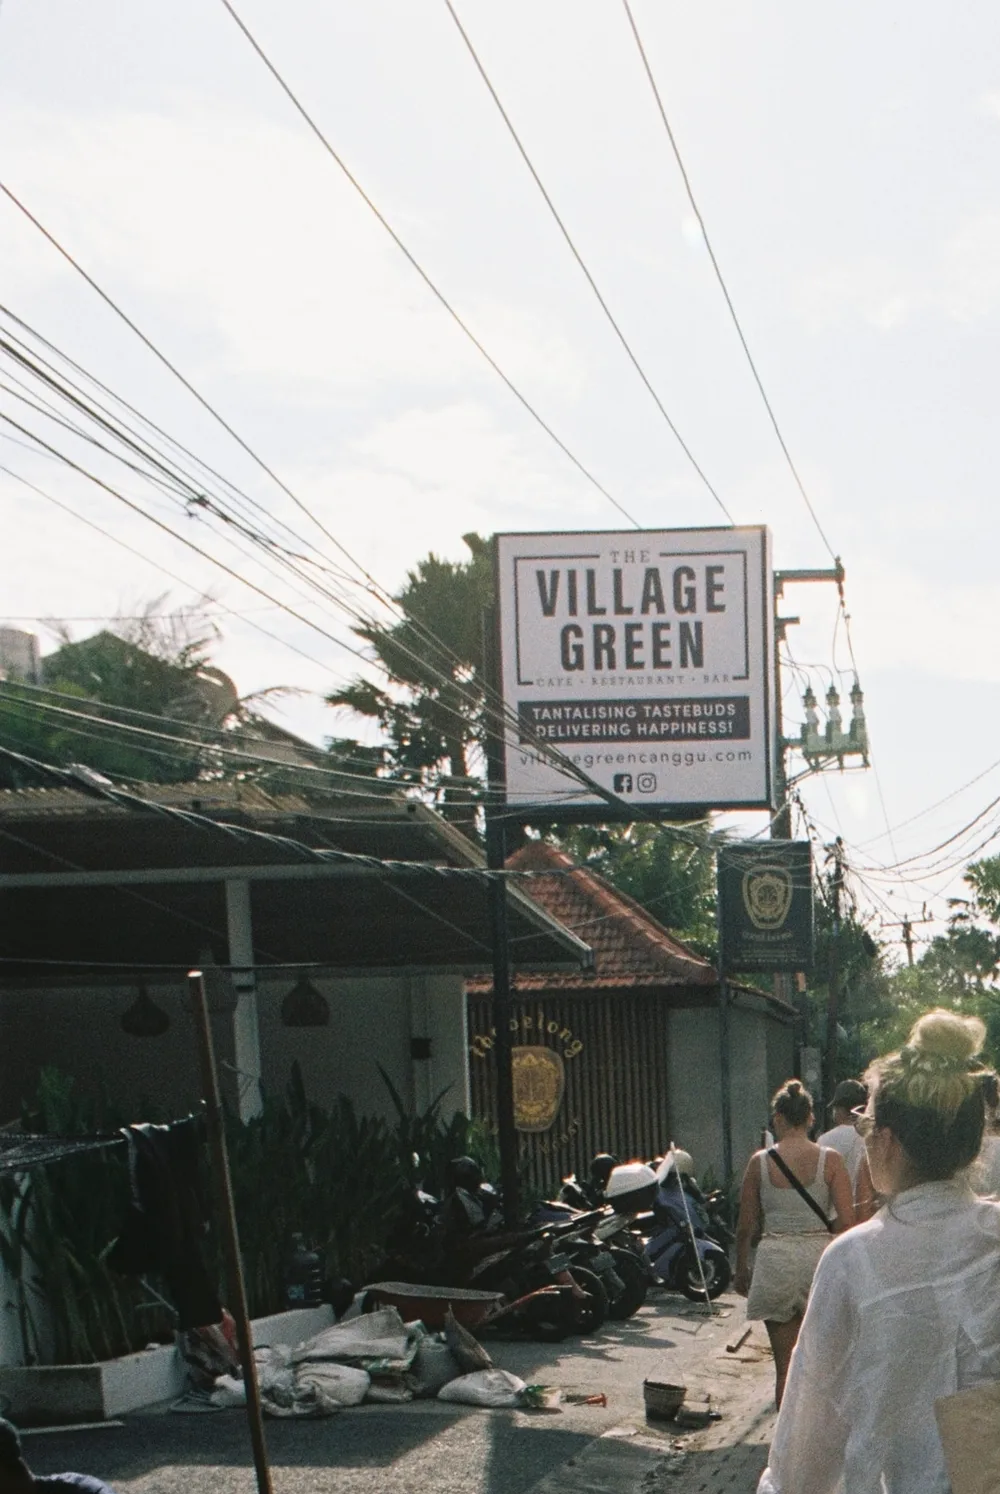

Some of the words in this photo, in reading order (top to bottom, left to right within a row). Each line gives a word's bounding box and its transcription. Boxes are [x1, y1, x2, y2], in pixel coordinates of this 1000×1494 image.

[609, 549, 652, 564] THE
[536, 566, 726, 616] VILLAGE
[560, 621, 705, 672] GREEN
[591, 675, 685, 687] RESTAURANT
[702, 673, 731, 684] BAR
[532, 706, 638, 721] TANTALISING
[643, 703, 737, 719] TASTEBUDS
[535, 724, 632, 739] DELIVERING
[636, 721, 734, 735] HAPPINESS!
[519, 750, 752, 768] villegreencanggu.com
